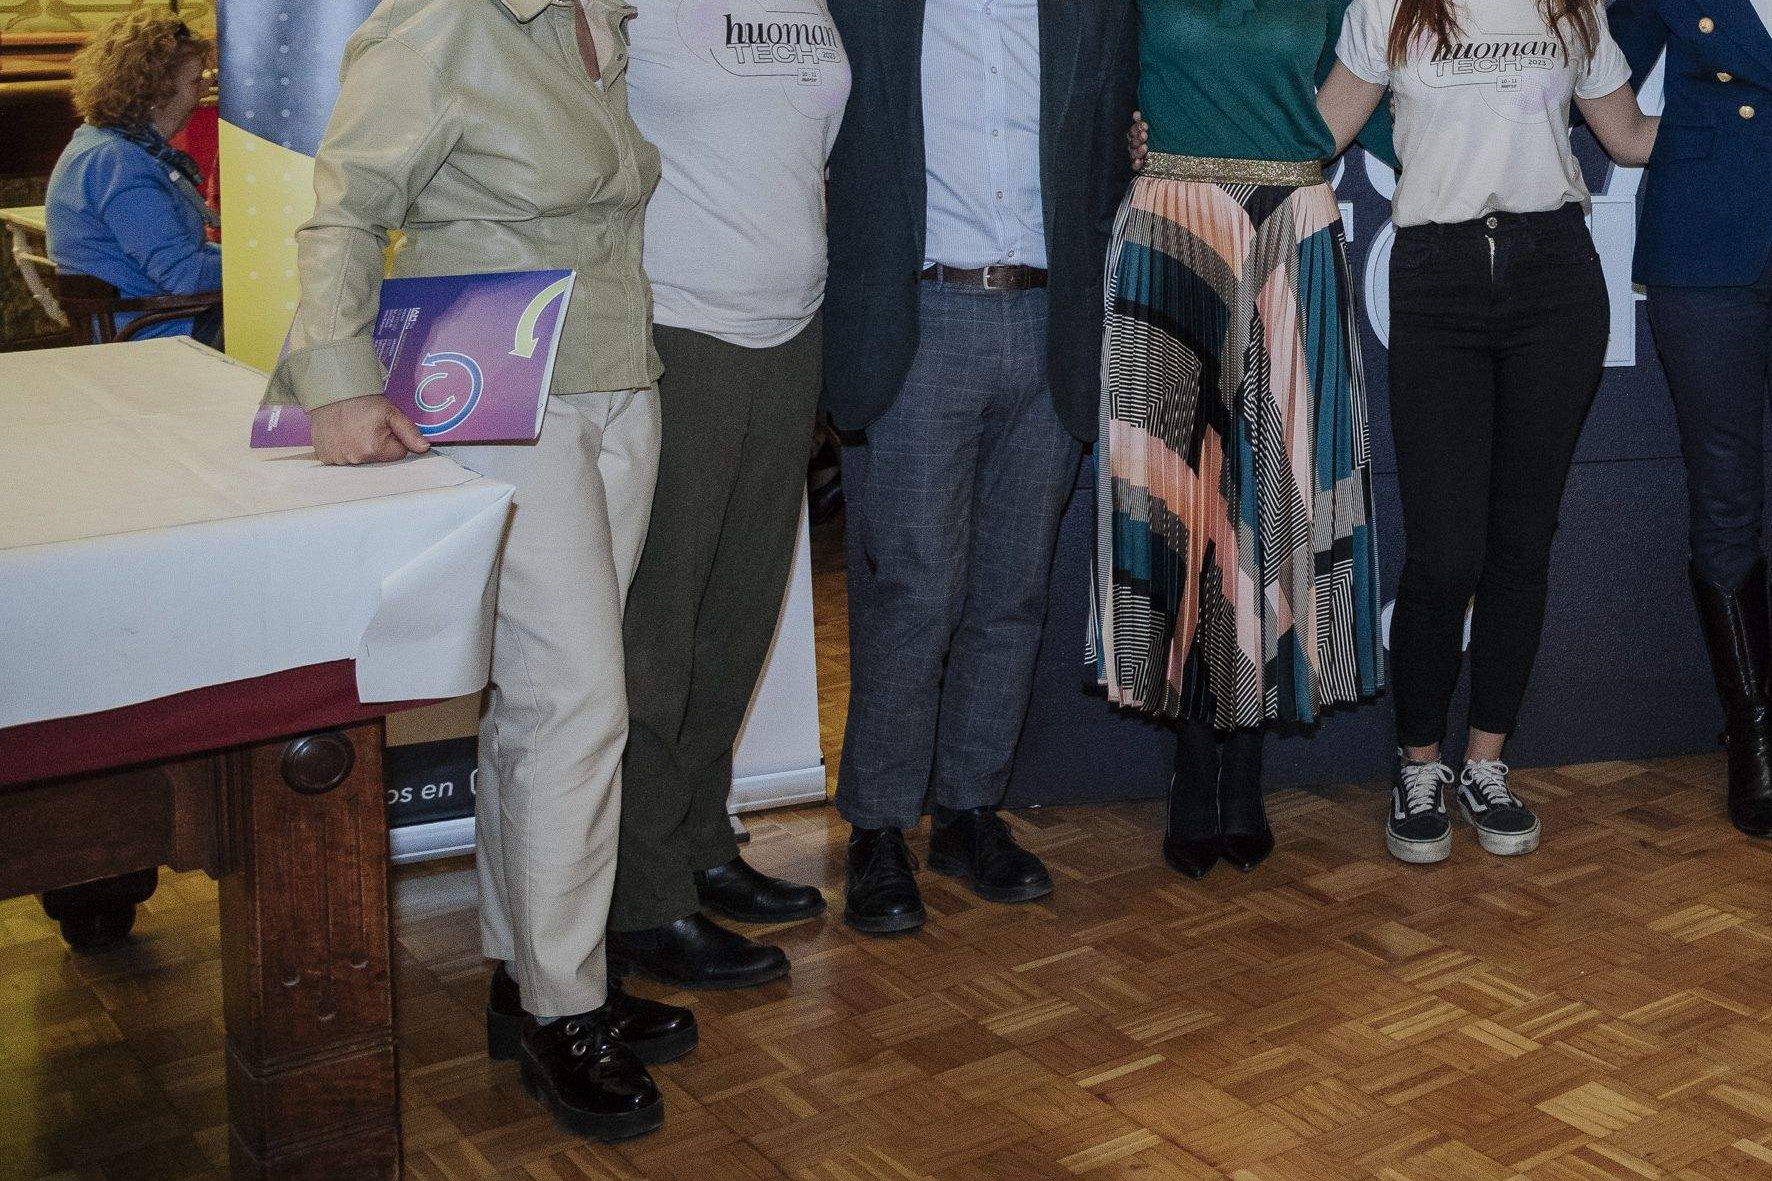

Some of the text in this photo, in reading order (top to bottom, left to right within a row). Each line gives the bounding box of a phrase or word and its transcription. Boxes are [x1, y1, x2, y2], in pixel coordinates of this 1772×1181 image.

[722, 13, 838, 48] huoman
[726, 43, 820, 64] TECH
[1430, 55, 1522, 77] TECH
[421, 781, 454, 800] en
